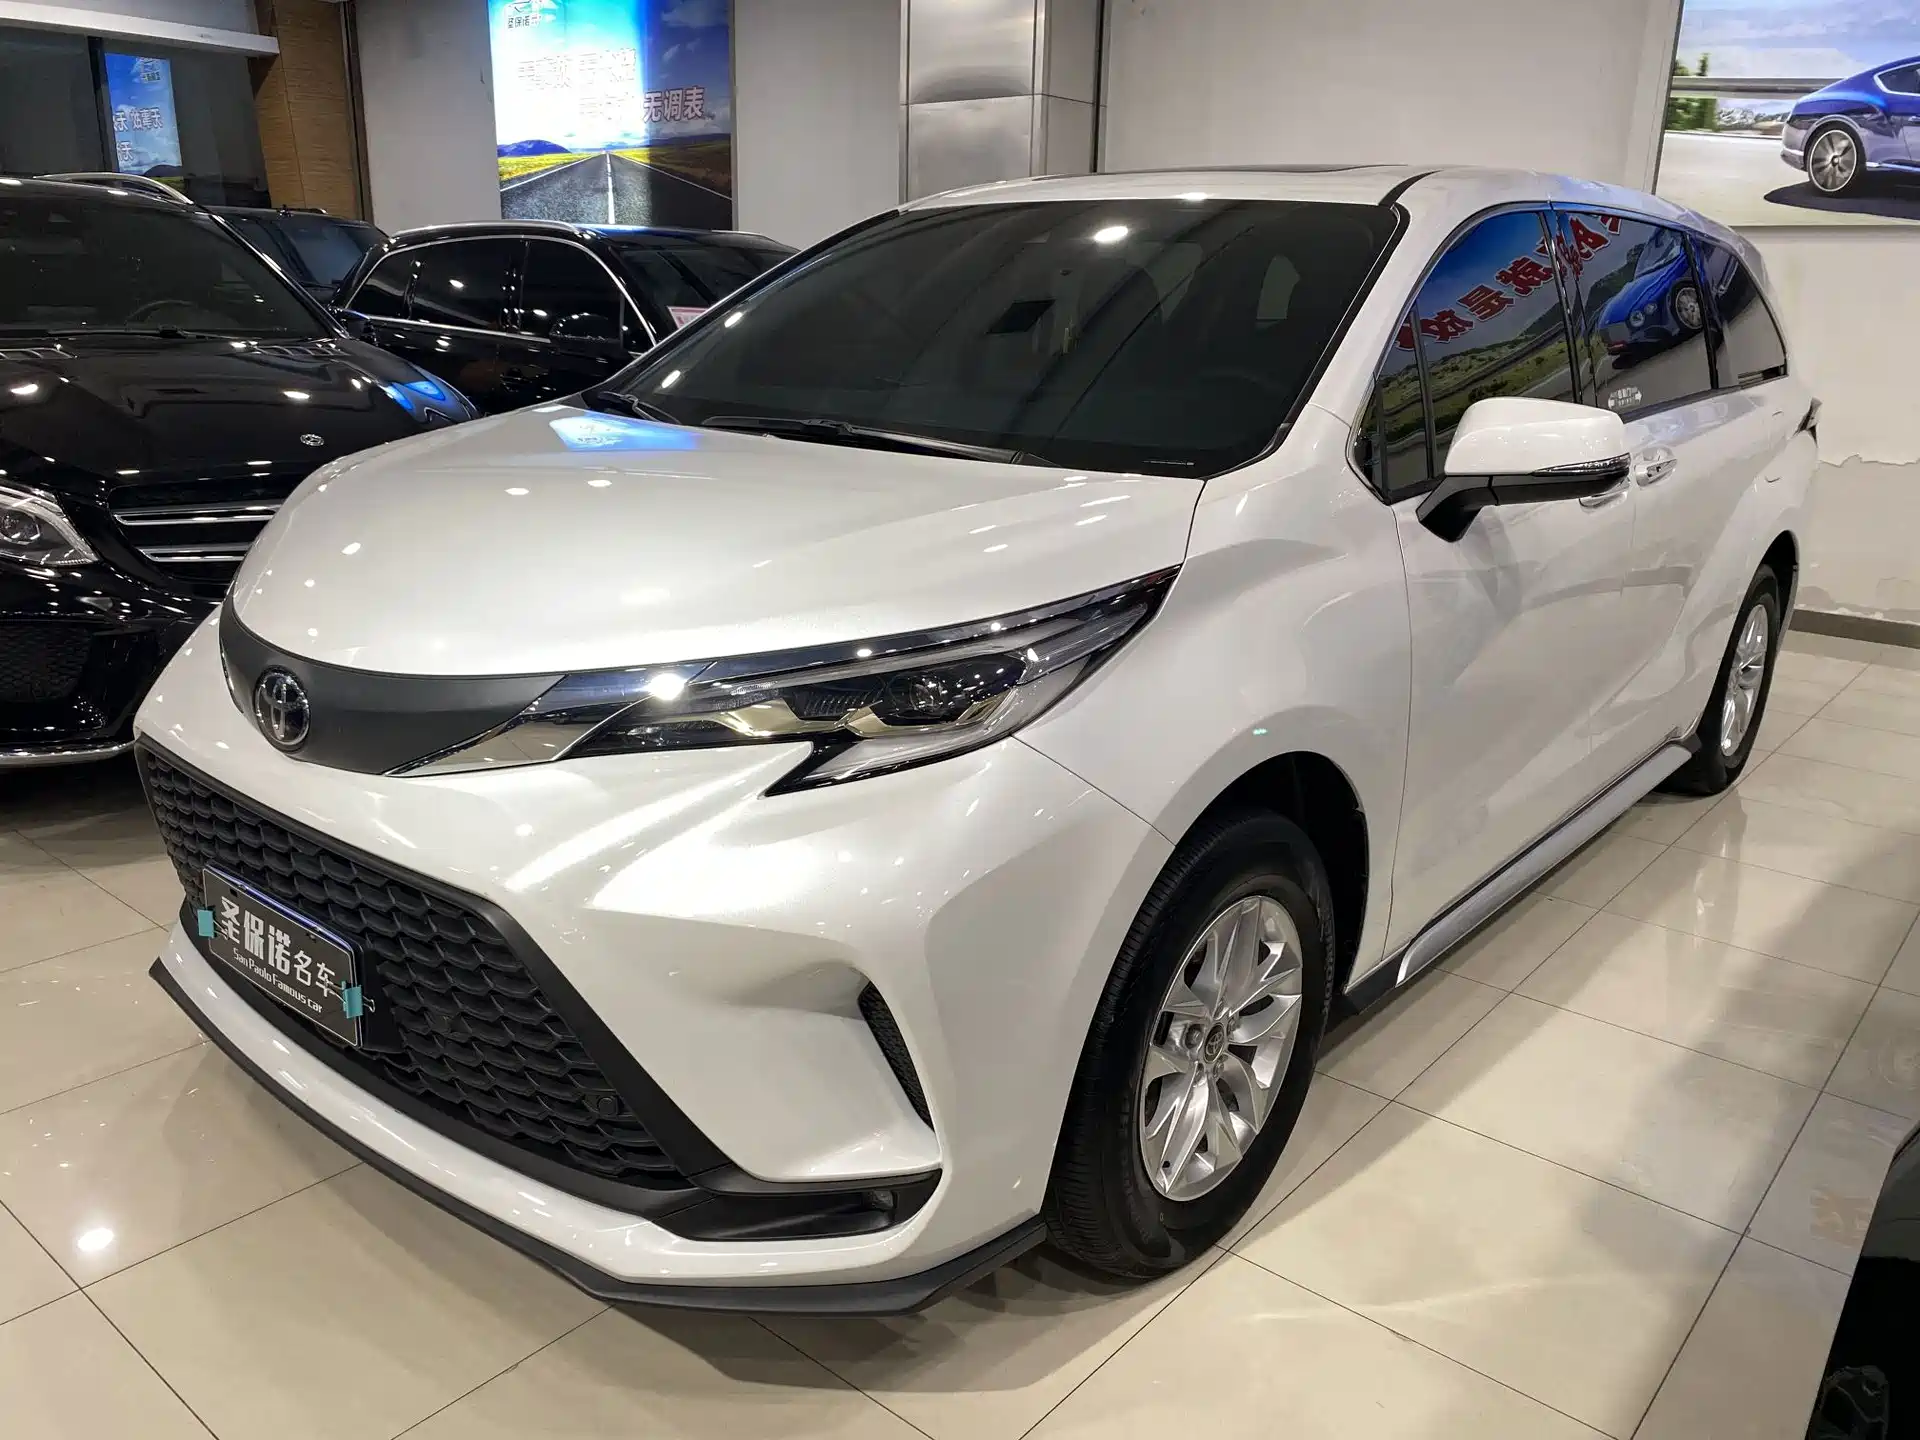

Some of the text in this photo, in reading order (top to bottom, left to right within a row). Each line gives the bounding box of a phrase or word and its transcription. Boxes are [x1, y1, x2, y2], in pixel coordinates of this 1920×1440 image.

[642, 87, 705, 123] 无调表
[221, 896, 336, 998] 圣保诺名车
[233, 947, 323, 1013] San Paolo Famous car
